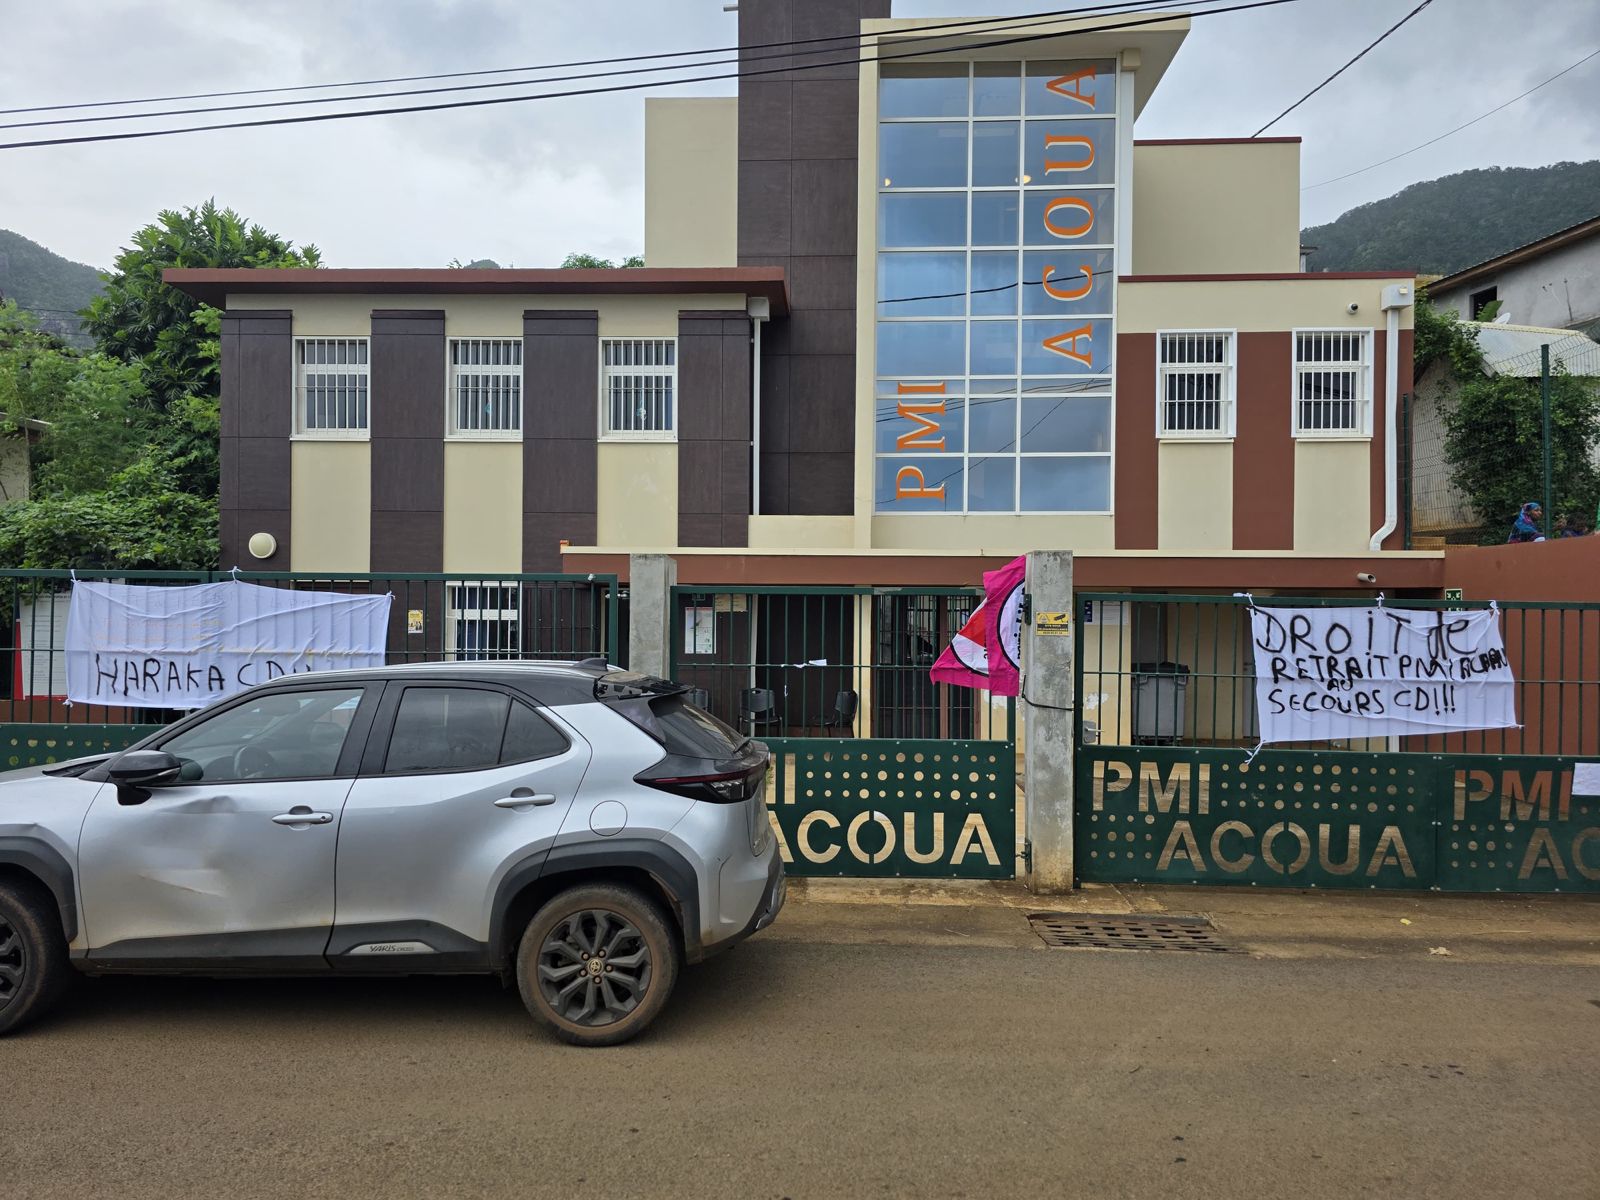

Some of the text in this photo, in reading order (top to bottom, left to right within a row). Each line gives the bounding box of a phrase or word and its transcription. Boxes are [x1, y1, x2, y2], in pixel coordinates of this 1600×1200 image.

[1042, 65, 1098, 370] ACOUA
[895, 380, 946, 502] PMI
[1427, 611, 1478, 661] de
[95, 653, 225, 696] HARAKA
[1268, 684, 1456, 716] SECOURS CD!!!
[1092, 760, 1210, 814] PMI
[1453, 769, 1573, 822] PMI
[1156, 820, 1417, 878] ACOUA
[369, 944, 396, 952] YARIS
